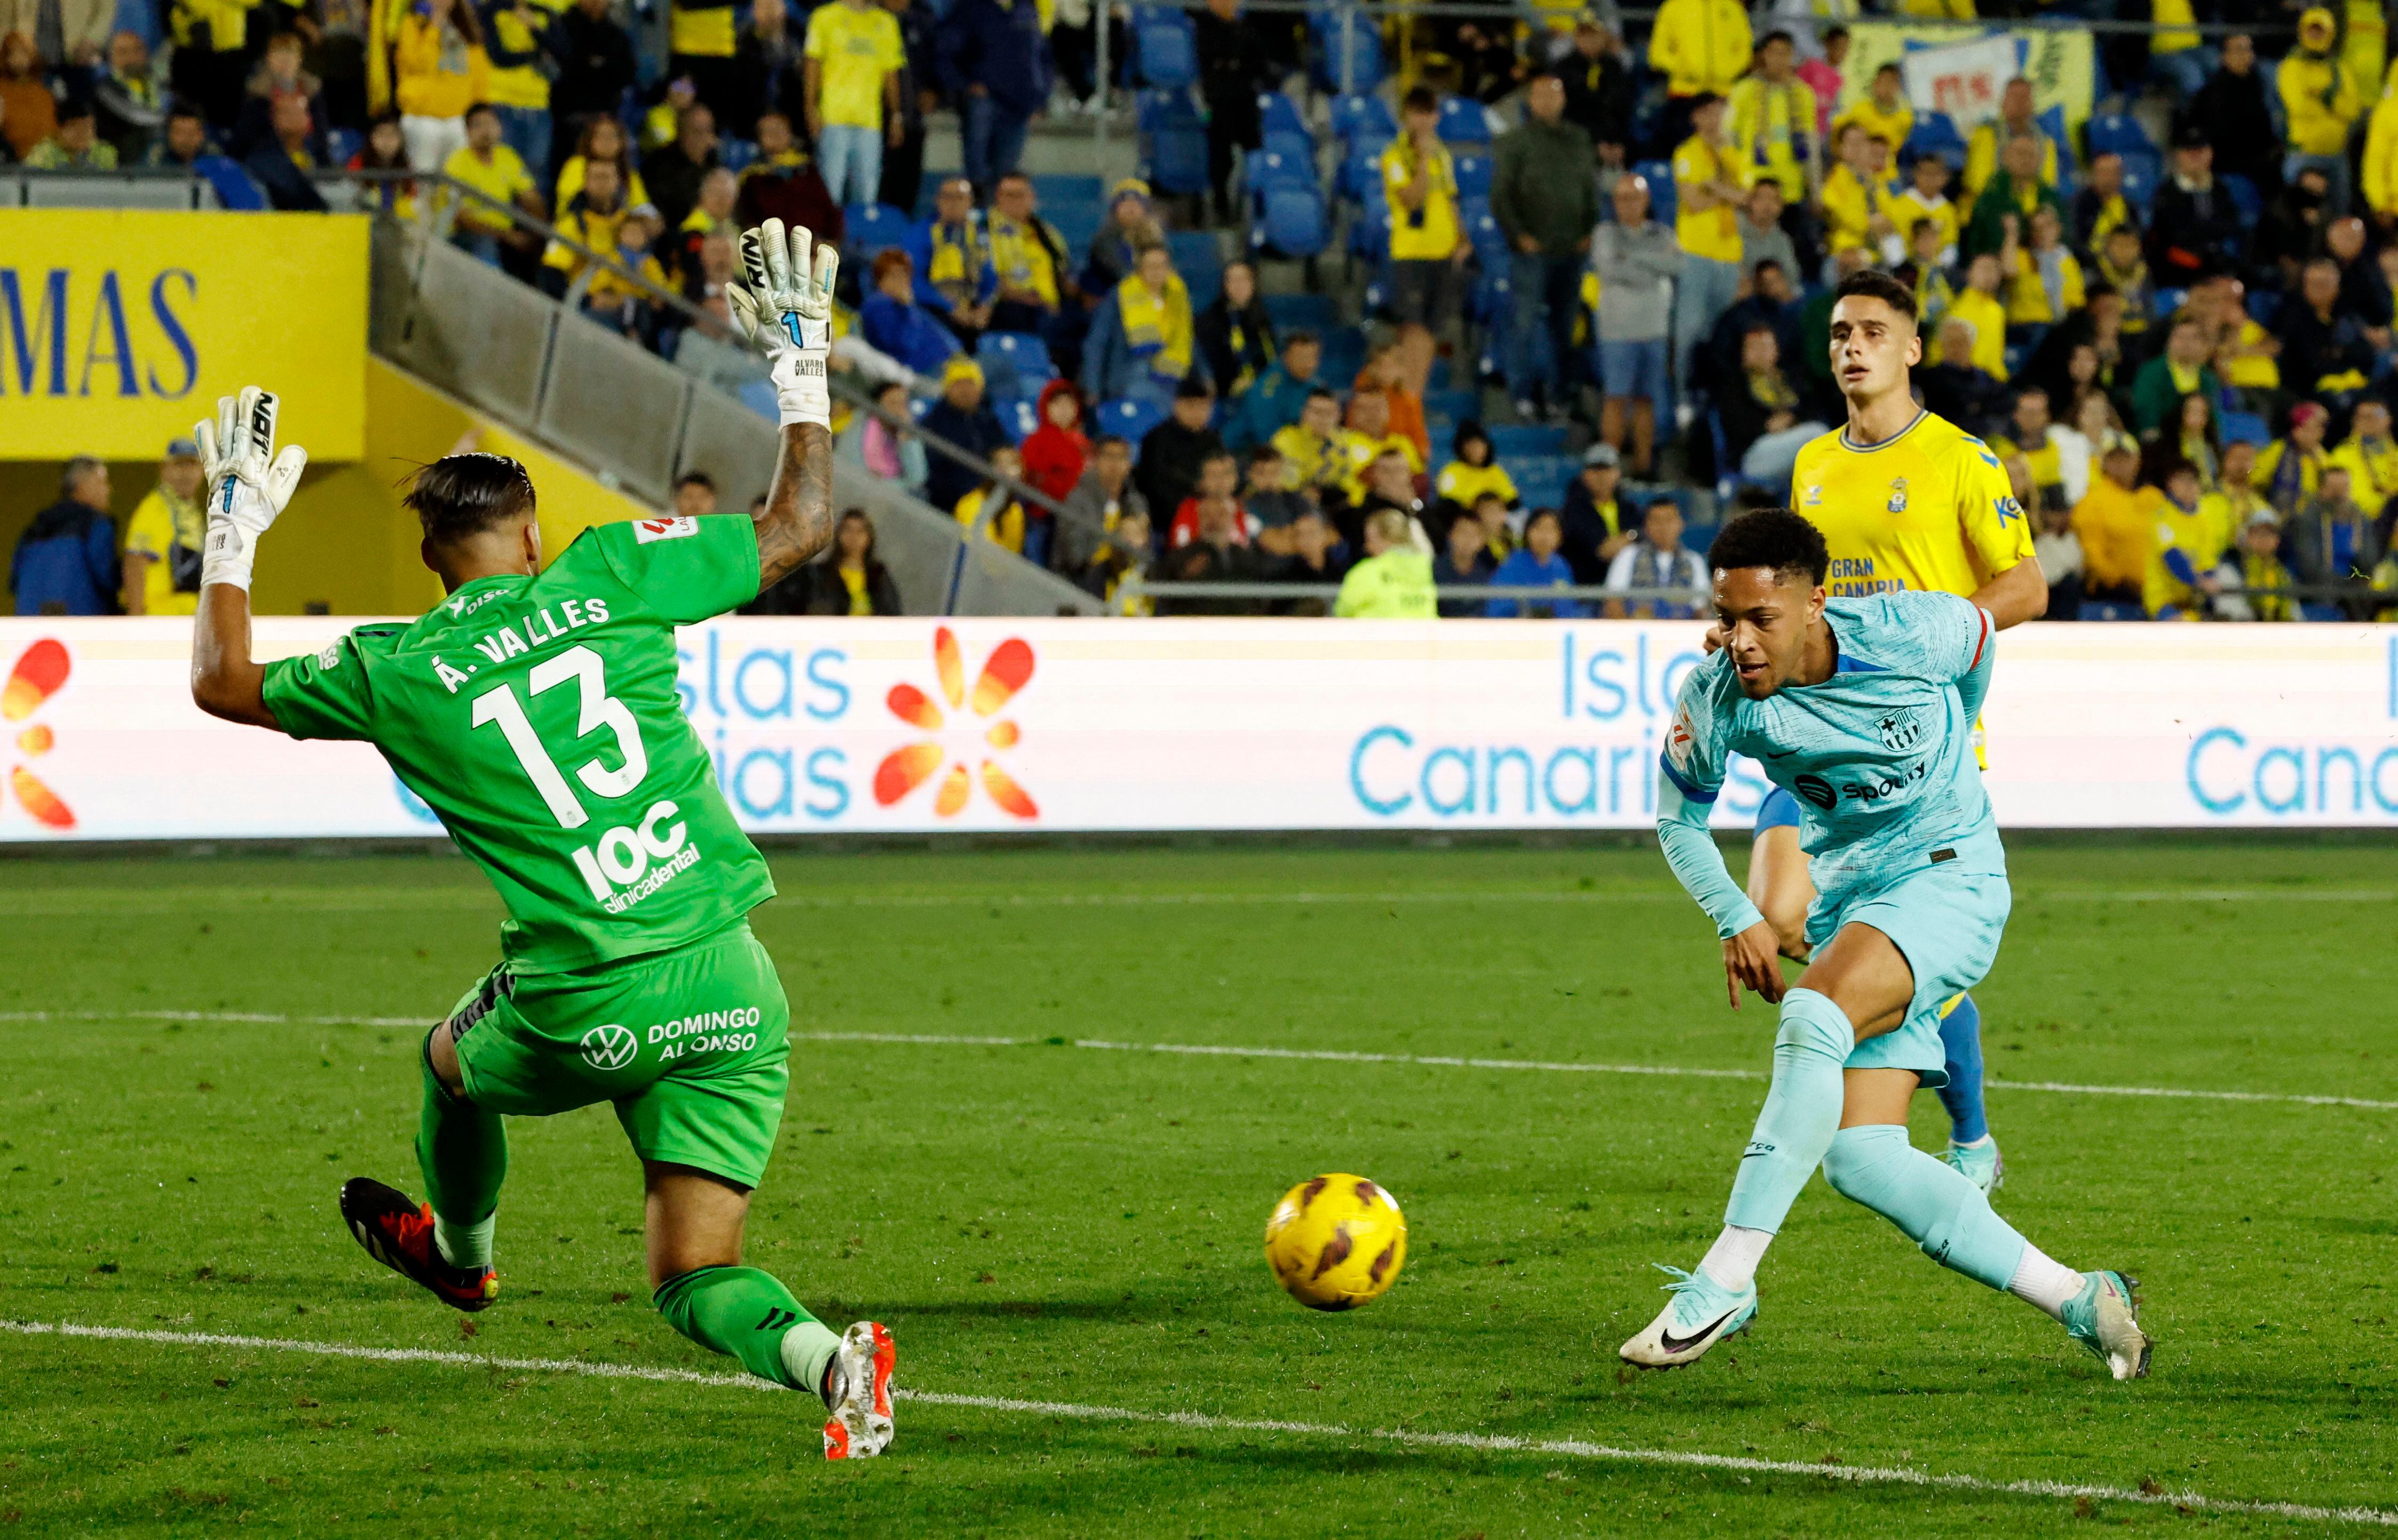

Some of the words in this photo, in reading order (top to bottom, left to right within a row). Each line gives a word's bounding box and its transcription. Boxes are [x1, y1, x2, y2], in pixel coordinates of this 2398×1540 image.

[0, 268, 199, 400] MAS
[795, 359, 824, 369] ALVARO
[795, 368, 824, 377] VALLES
[1832, 558, 1874, 578] GRAN
[472, 598, 610, 664] VALLES
[471, 644, 648, 829] 13
[571, 800, 687, 903] IOC
[648, 1006, 760, 1044] DOMINGO
[658, 1032, 757, 1062] ALONSO
